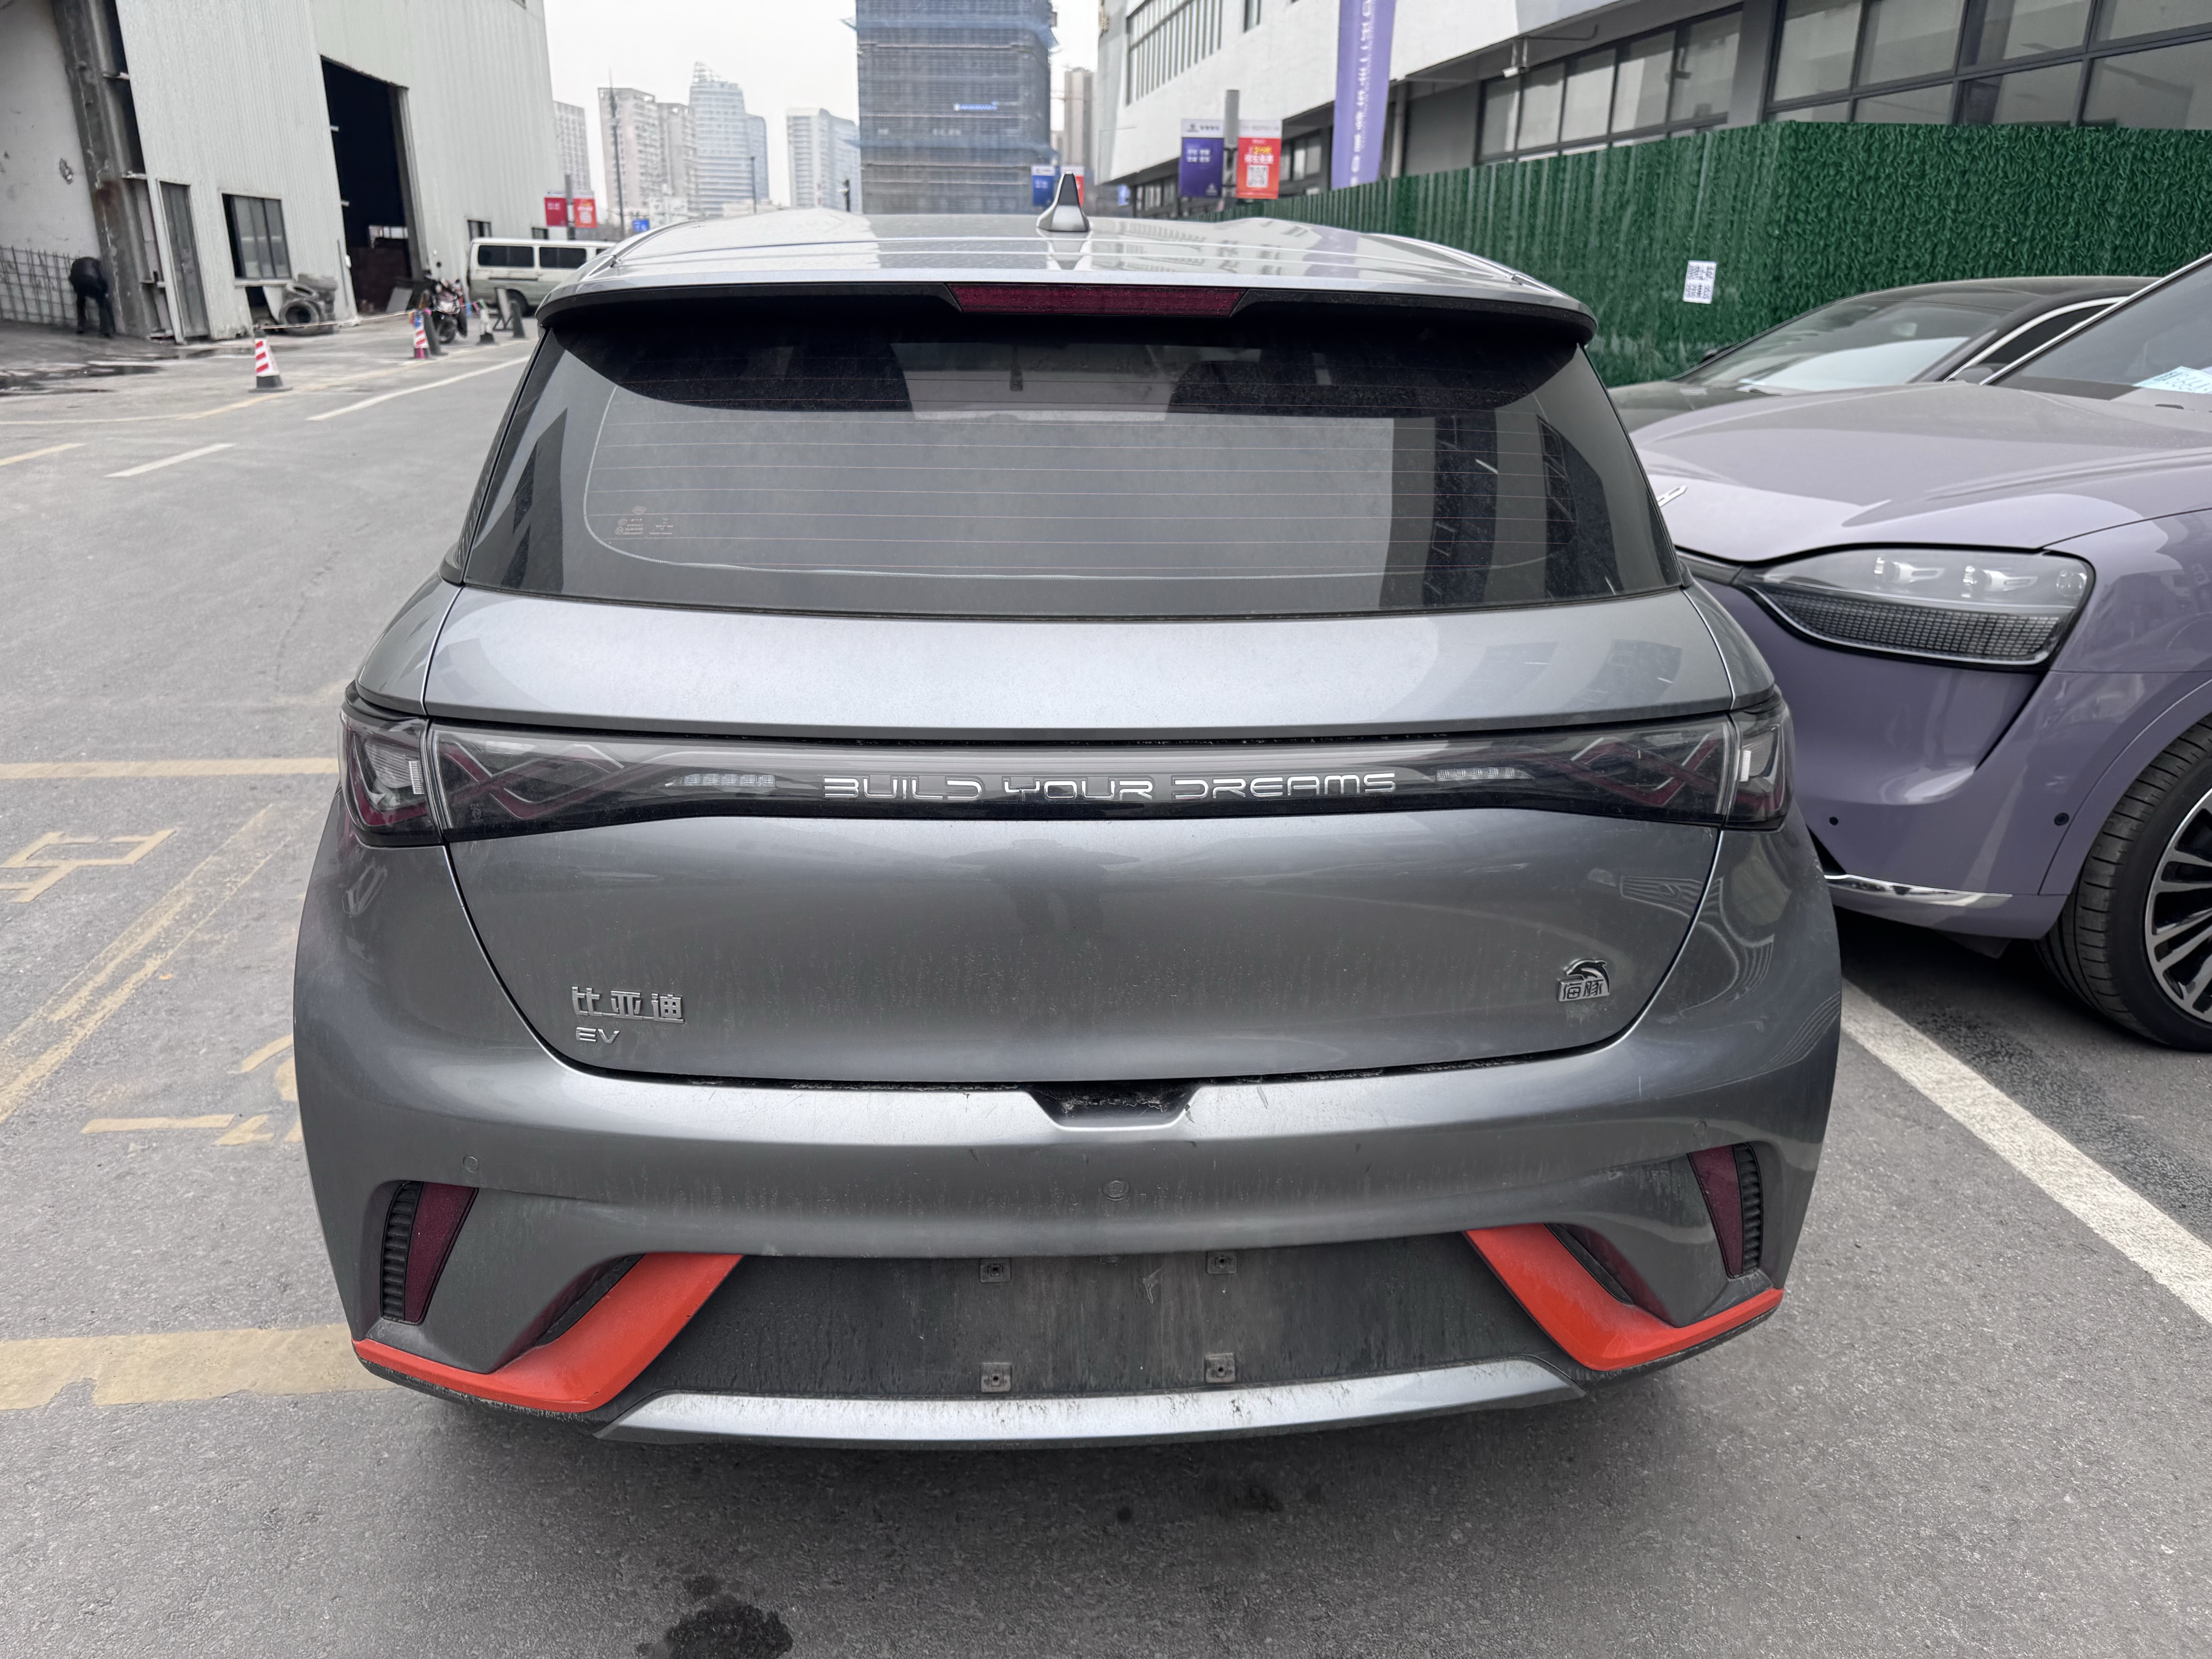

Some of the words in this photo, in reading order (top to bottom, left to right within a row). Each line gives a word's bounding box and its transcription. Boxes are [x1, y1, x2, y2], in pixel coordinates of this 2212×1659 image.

[824, 778, 982, 800] BUILD
[1004, 780, 1153, 801] YOUR
[1175, 773, 1395, 799] DREAMS
[1562, 979, 1604, 1000] 海豚
[572, 986, 685, 1024] 比亚迪
[576, 1027, 620, 1044] EV
